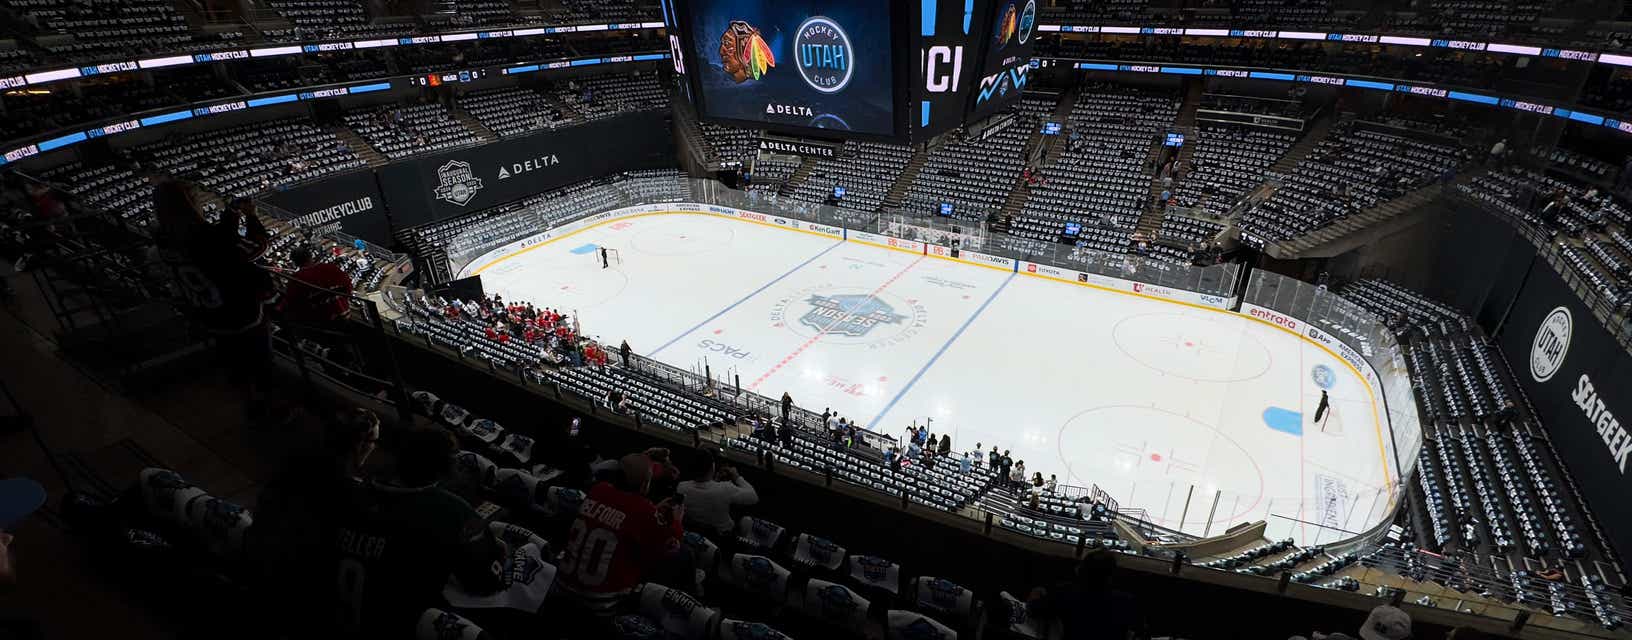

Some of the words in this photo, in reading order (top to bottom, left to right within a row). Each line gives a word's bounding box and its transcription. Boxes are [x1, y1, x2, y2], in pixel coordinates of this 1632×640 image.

[803, 25, 839, 42] HOCKEY
[1432, 39, 1449, 47] UTAH
[1448, 40, 1470, 49] HOCKEY
[1469, 42, 1486, 50] CLUB
[194, 54, 211, 62] UTAH
[210, 52, 233, 61] HOCKEY
[233, 50, 248, 59] CLUB
[802, 43, 846, 71] UTAH
[1542, 48, 1560, 57] UTAH
[1559, 49, 1582, 60] HOCKEY
[1581, 51, 1598, 62] CLUB
[81, 66, 99, 76] UTAH
[98, 63, 120, 74] HOCKEY
[119, 61, 138, 71] CLUB
[814, 74, 837, 87] CLUB
[776, 105, 813, 117] DELTA
[767, 142, 797, 153] DELTA
[799, 144, 834, 158] CENTER
[513, 154, 561, 175] DELTA
[442, 173, 471, 187] SEASON
[812, 307, 878, 328] SEASON
[1250, 308, 1297, 330] entrata
[1571, 373, 1632, 475] SEATGEEK
